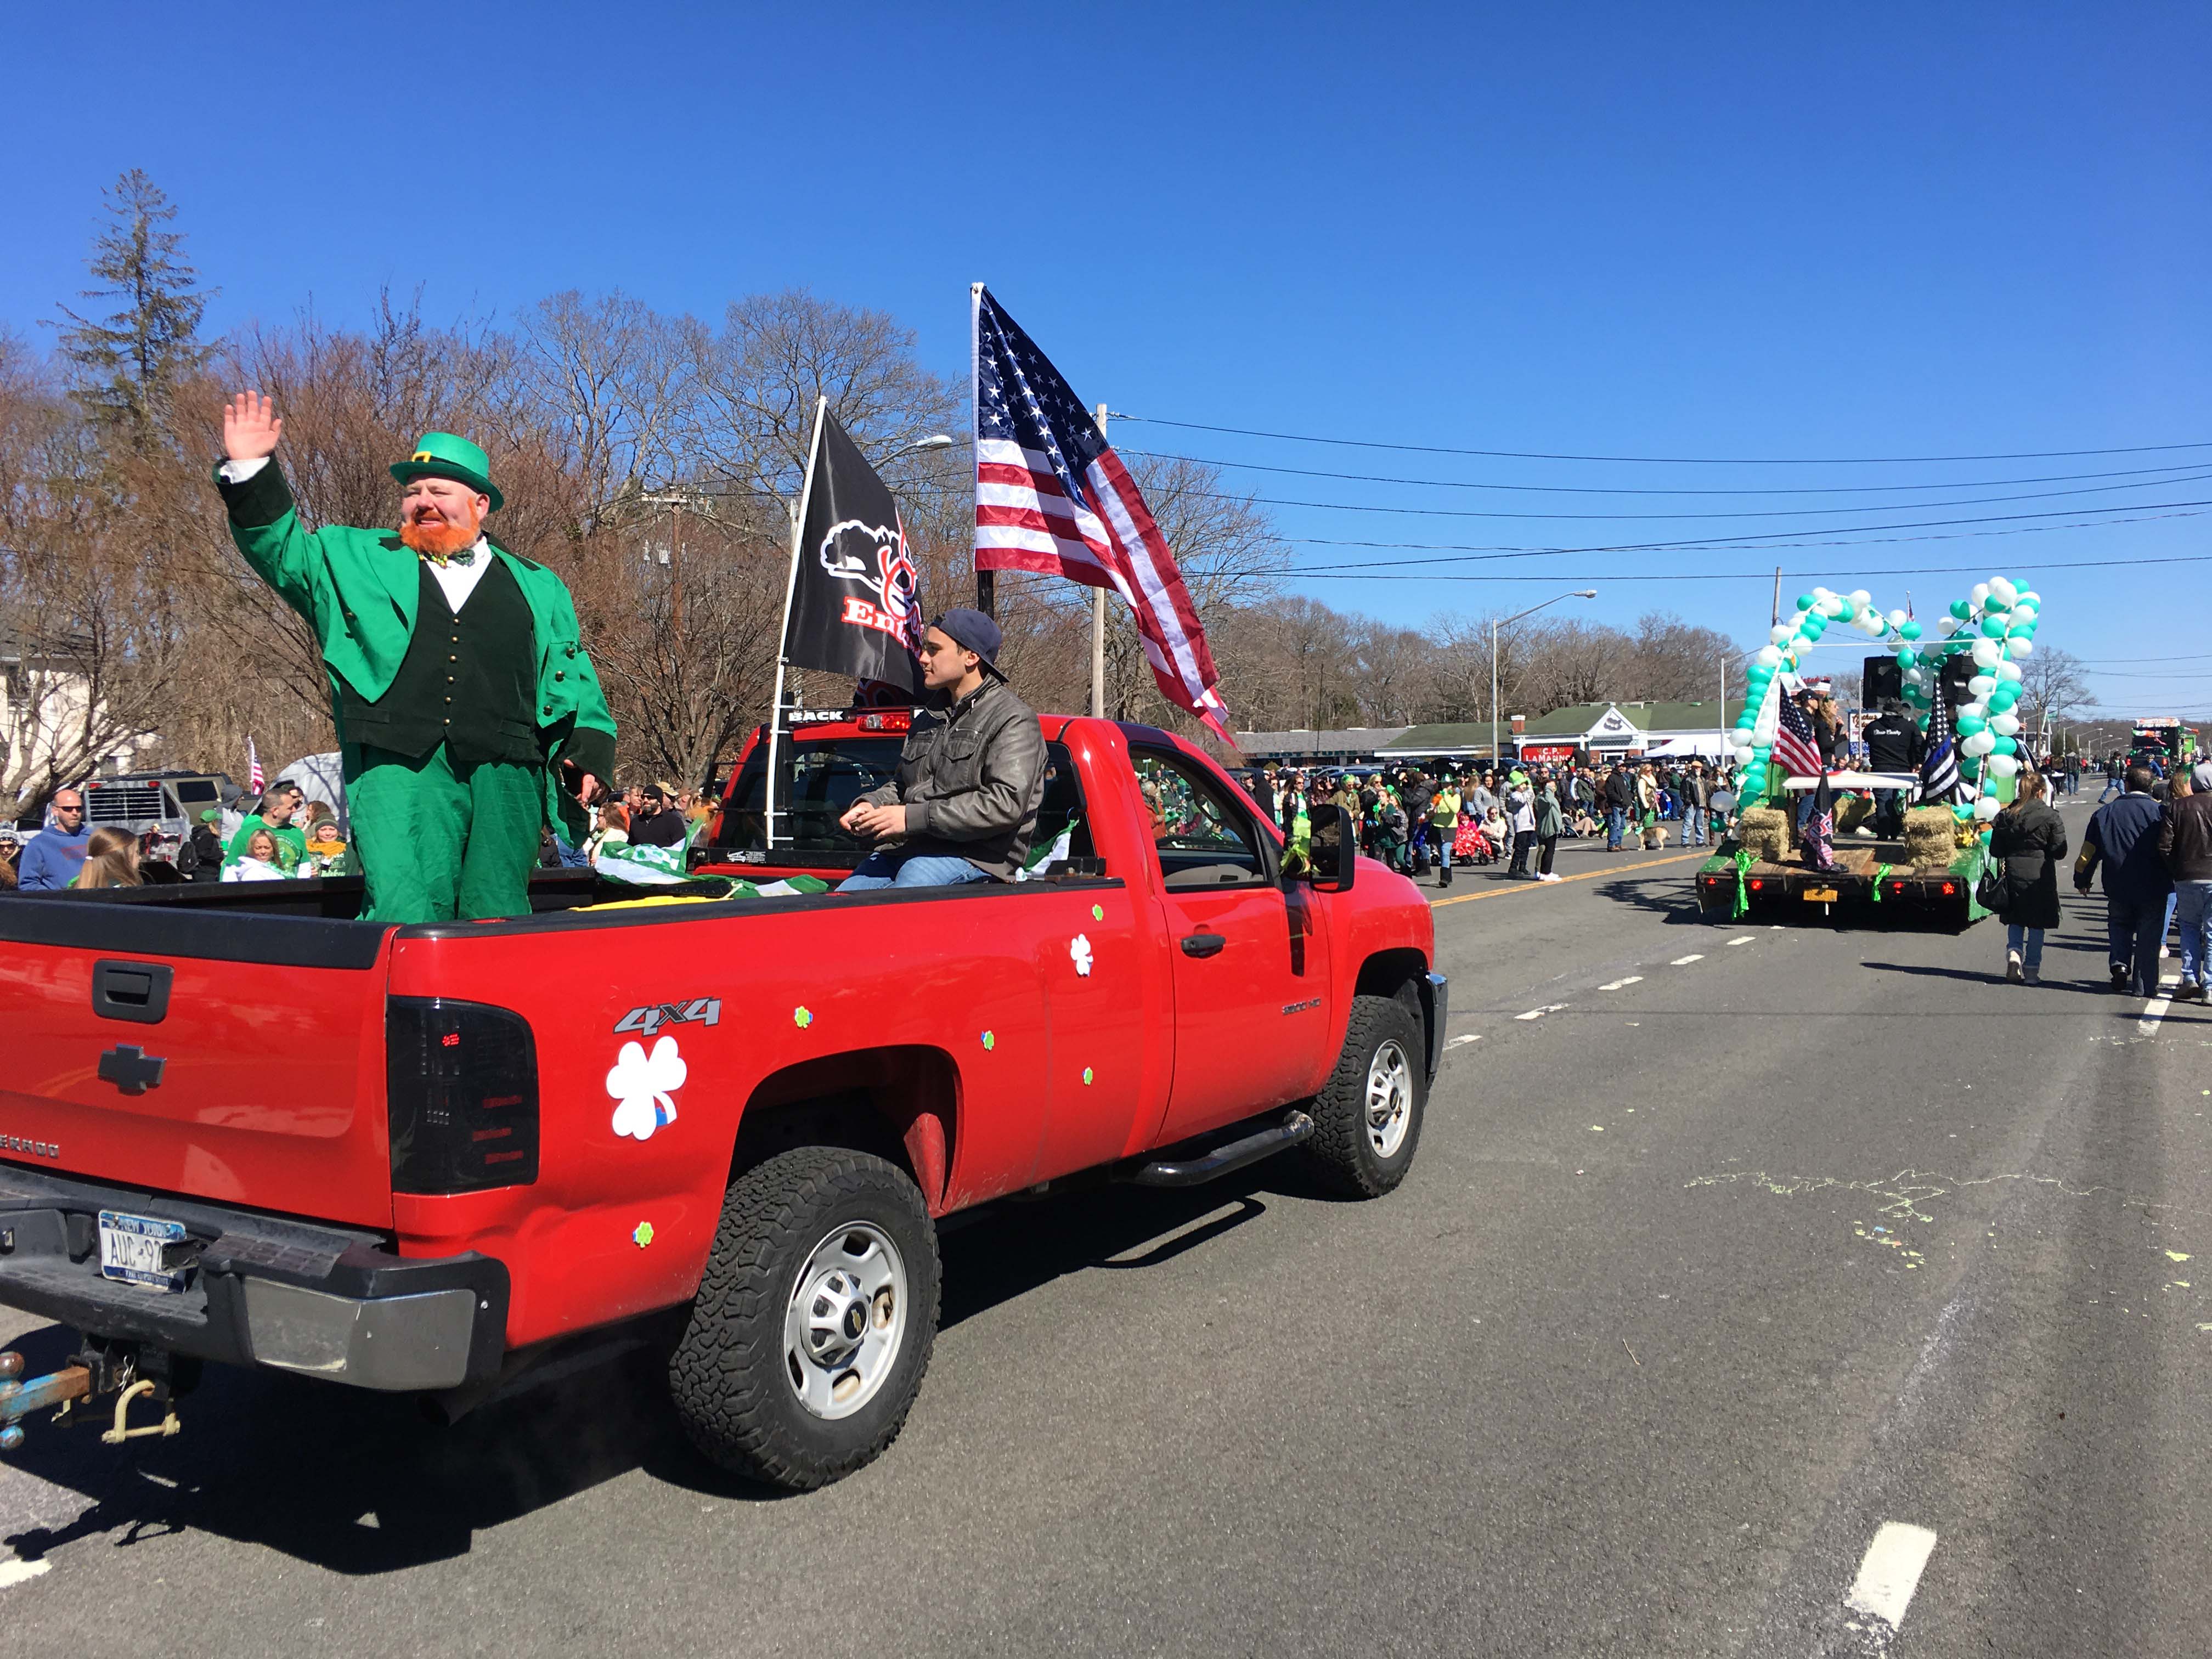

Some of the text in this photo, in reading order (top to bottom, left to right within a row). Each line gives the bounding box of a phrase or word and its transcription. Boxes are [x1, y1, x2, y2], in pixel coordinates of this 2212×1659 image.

[788, 710, 843, 722] BACK
[119, 1217, 166, 1238] NEW YORK
